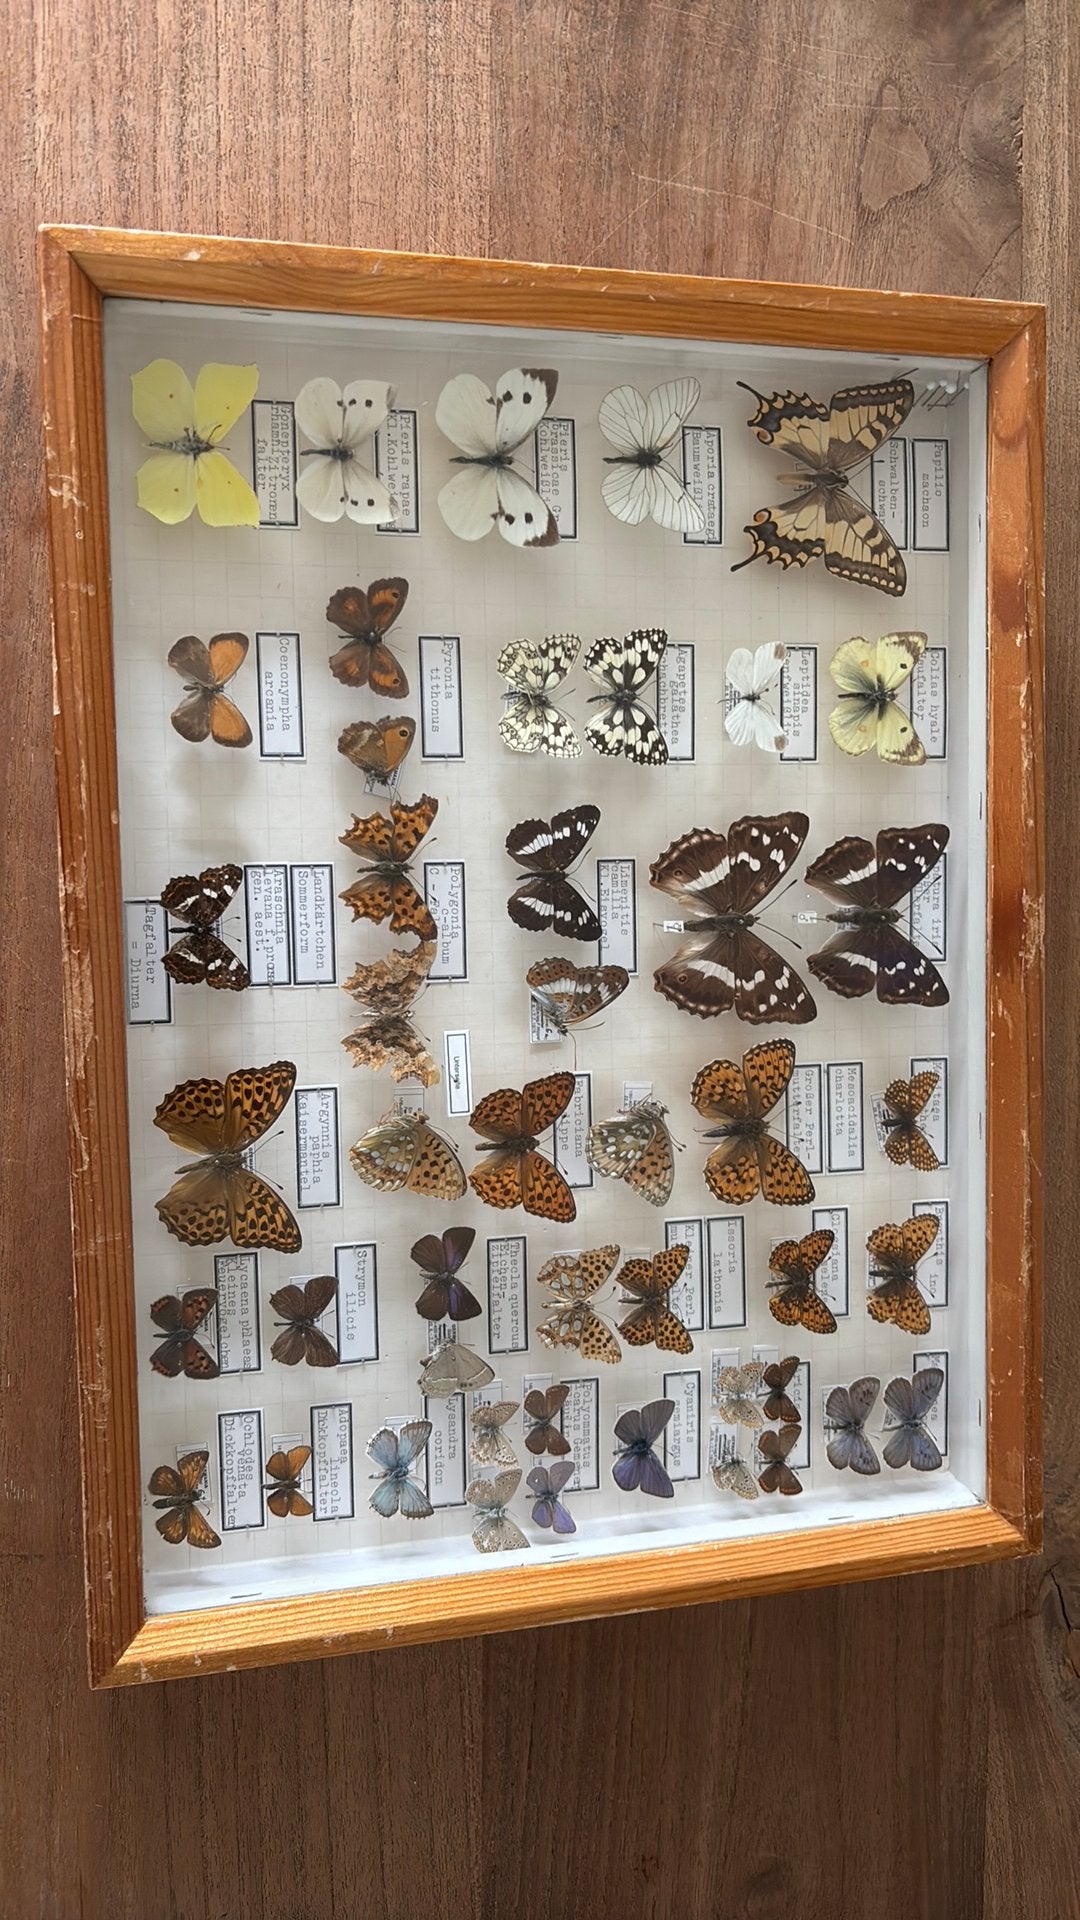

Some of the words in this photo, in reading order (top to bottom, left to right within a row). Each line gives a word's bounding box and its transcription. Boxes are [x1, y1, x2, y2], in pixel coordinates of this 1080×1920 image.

[257, 438, 268, 490] falter
[280, 407, 291, 492] Gonepteryx
[400, 416, 411, 465] Pieris
[558, 424, 569, 471] Pieris
[705, 432, 717, 478] Aporia
[400, 474, 410, 516] rapae
[889, 441, 898, 518] Schwalben-
[932, 444, 943, 496] Papilio
[706, 484, 717, 542] crataegi
[922, 473, 930, 528] machaon
[279, 638, 292, 731] Coenonympha
[442, 641, 454, 700] Pyronia
[677, 649, 688, 712] Agapetes
[800, 650, 810, 713] Leptidea
[930, 652, 940, 696] Colias
[265, 671, 276, 731] arcania
[430, 667, 440, 732] tithonus
[670, 680, 680, 745] galathea
[792, 683, 801, 736] sinapis
[928, 705, 940, 743] hyale
[251, 870, 262, 900] gen.
[263, 870, 274, 919] levana
[274, 869, 285, 944] Araschnia
[298, 871, 310, 953] Sommerform
[449, 867, 460, 940] Polygonia
[611, 865, 620, 920] camilla
[620, 865, 630, 936] Limenitis
[143, 907, 156, 984] Tagfalter
[254, 912, 265, 951] aest.
[313, 870, 325, 969] Landkärtchen
[441, 908, 450, 964] c-album
[130, 958, 141, 1009] Diurna
[574, 1080, 583, 1158] Fabriciana
[804, 1069, 814, 1115] Großer
[835, 1068, 844, 1136] charlotta
[847, 1067, 857, 1157] Mesoacidalia
[298, 1093, 310, 1192] Kaisermantel
[319, 1093, 332, 1158] Argynnis
[806, 1123, 815, 1160] Perl-
[310, 1135, 321, 1184] paphia
[500, 1243, 509, 1299] Eichen-
[510, 1242, 520, 1289] Thecla
[728, 1220, 737, 1273] Issoria
[226, 1256, 237, 1316] Kleines
[236, 1256, 251, 1315] Lycaena
[355, 1250, 367, 1307] Strymon
[491, 1244, 502, 1338] zipfelfalter
[685, 1287, 695, 1325] Perl-
[713, 1252, 723, 1313] lathonia
[239, 1320, 252, 1369] phlaeas
[346, 1292, 356, 1341] ilicis
[509, 1294, 520, 1349] quercus
[337, 1409, 350, 1464] Adopaea
[446, 1397, 458, 1460] Lysandra
[581, 1383, 592, 1468] Polyommatus
[684, 1383, 695, 1443] Cyaniris
[224, 1418, 237, 1528] Dickkopffalter
[237, 1449, 248, 1498] venata
[244, 1416, 255, 1480] Ochlodes
[317, 1411, 330, 1514] Dickkopffalter
[435, 1430, 445, 1486] coridon
[330, 1457, 340, 1514] lineola
